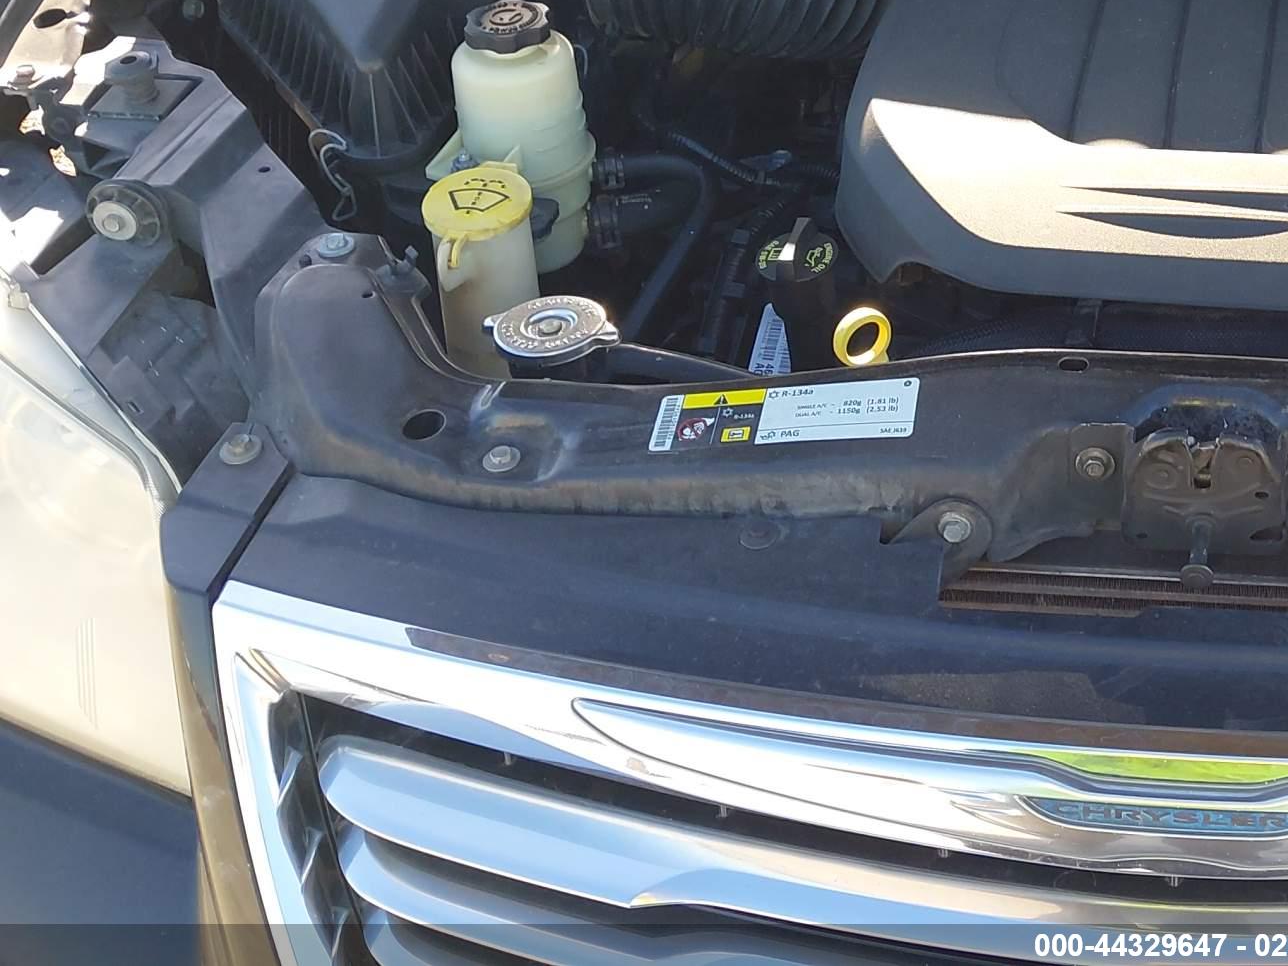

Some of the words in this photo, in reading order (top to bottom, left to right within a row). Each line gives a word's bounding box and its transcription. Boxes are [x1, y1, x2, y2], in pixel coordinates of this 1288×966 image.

[811, 263, 826, 273] OIL
[781, 389, 814, 397] R-134a
[843, 400, 862, 408] 820g
[837, 407, 861, 416] 1150g
[780, 430, 800, 438] PAG
[1058, 804, 1287, 828] CHRYSLER
